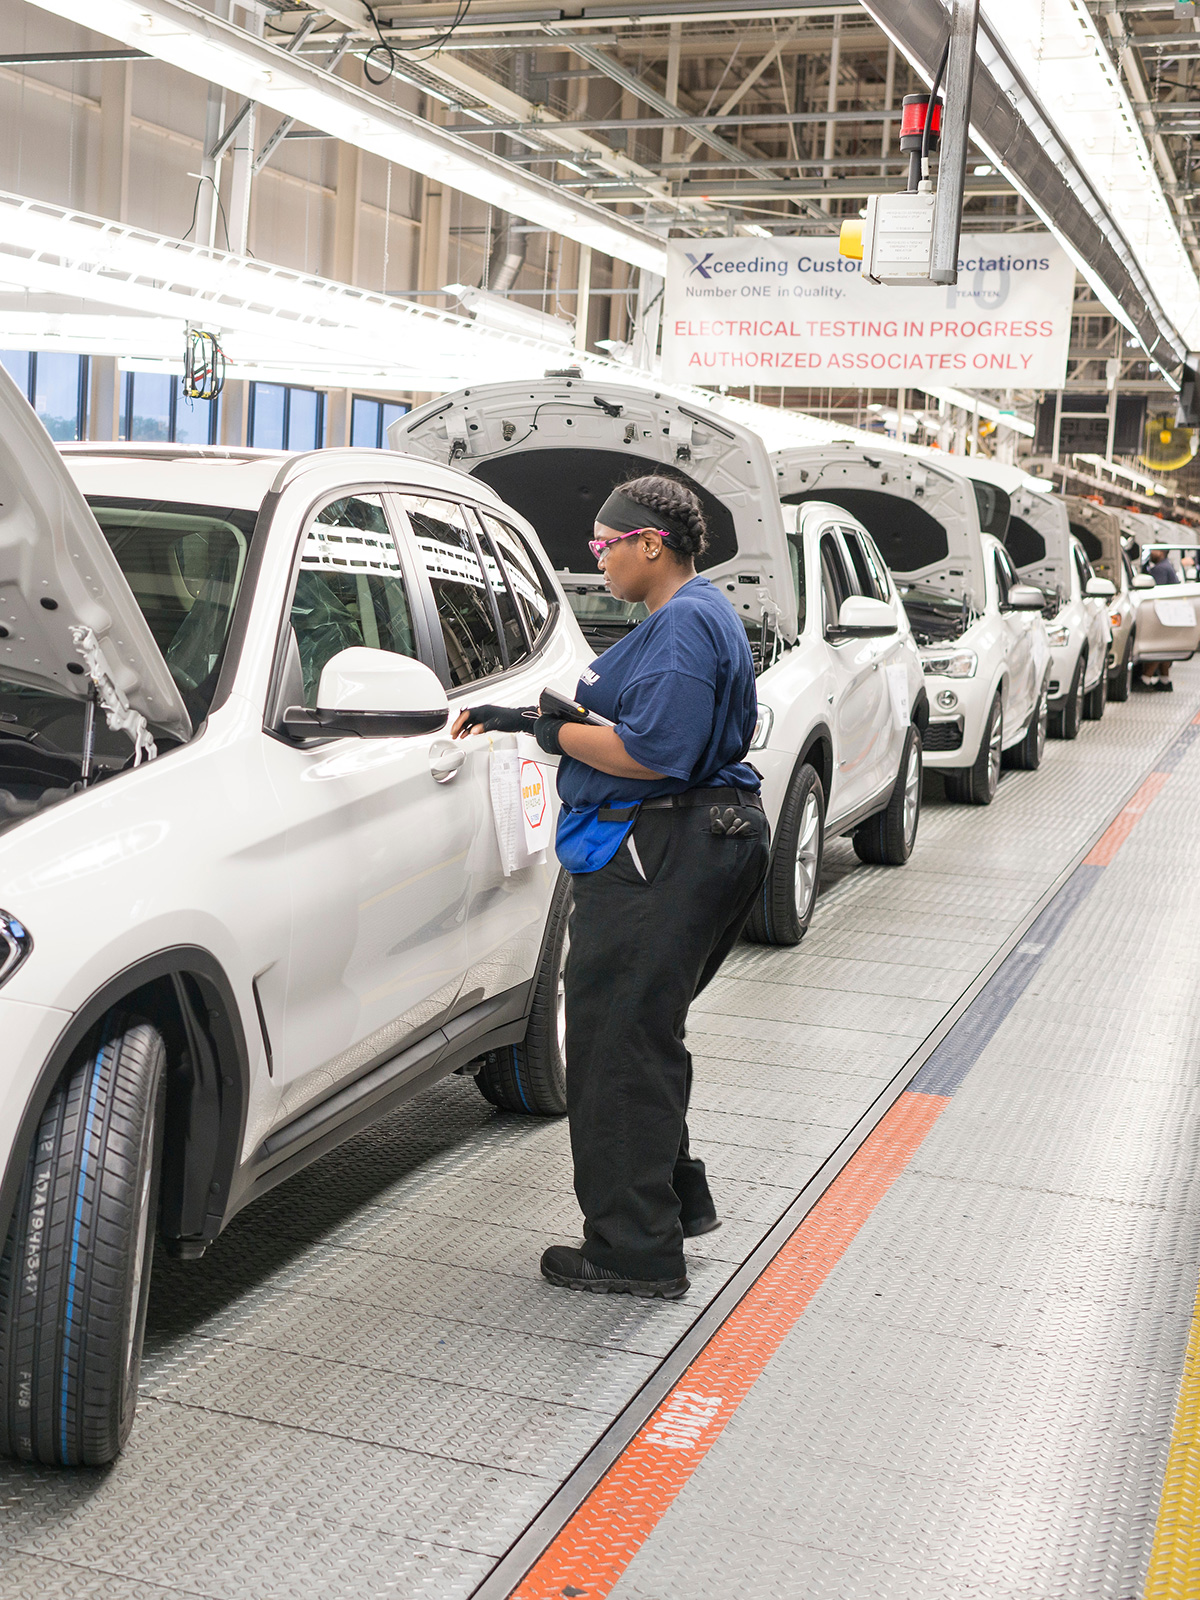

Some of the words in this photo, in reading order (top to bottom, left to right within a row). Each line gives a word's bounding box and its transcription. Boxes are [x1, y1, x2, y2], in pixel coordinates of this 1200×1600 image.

[957, 254, 1050, 272] ectations
[686, 286, 737, 297] Number
[741, 286, 771, 297] ONE
[778, 286, 789, 297] in
[793, 286, 847, 300] Quality.
[674, 320, 801, 337] ELECTRICAL
[807, 320, 898, 337] TESTING
[903, 321, 924, 337] IN
[930, 321, 1053, 338] PROGRESS
[688, 351, 823, 369] AUTHORIZED
[827, 352, 967, 370] ASSOCIATES
[972, 353, 1033, 370] ONLY
